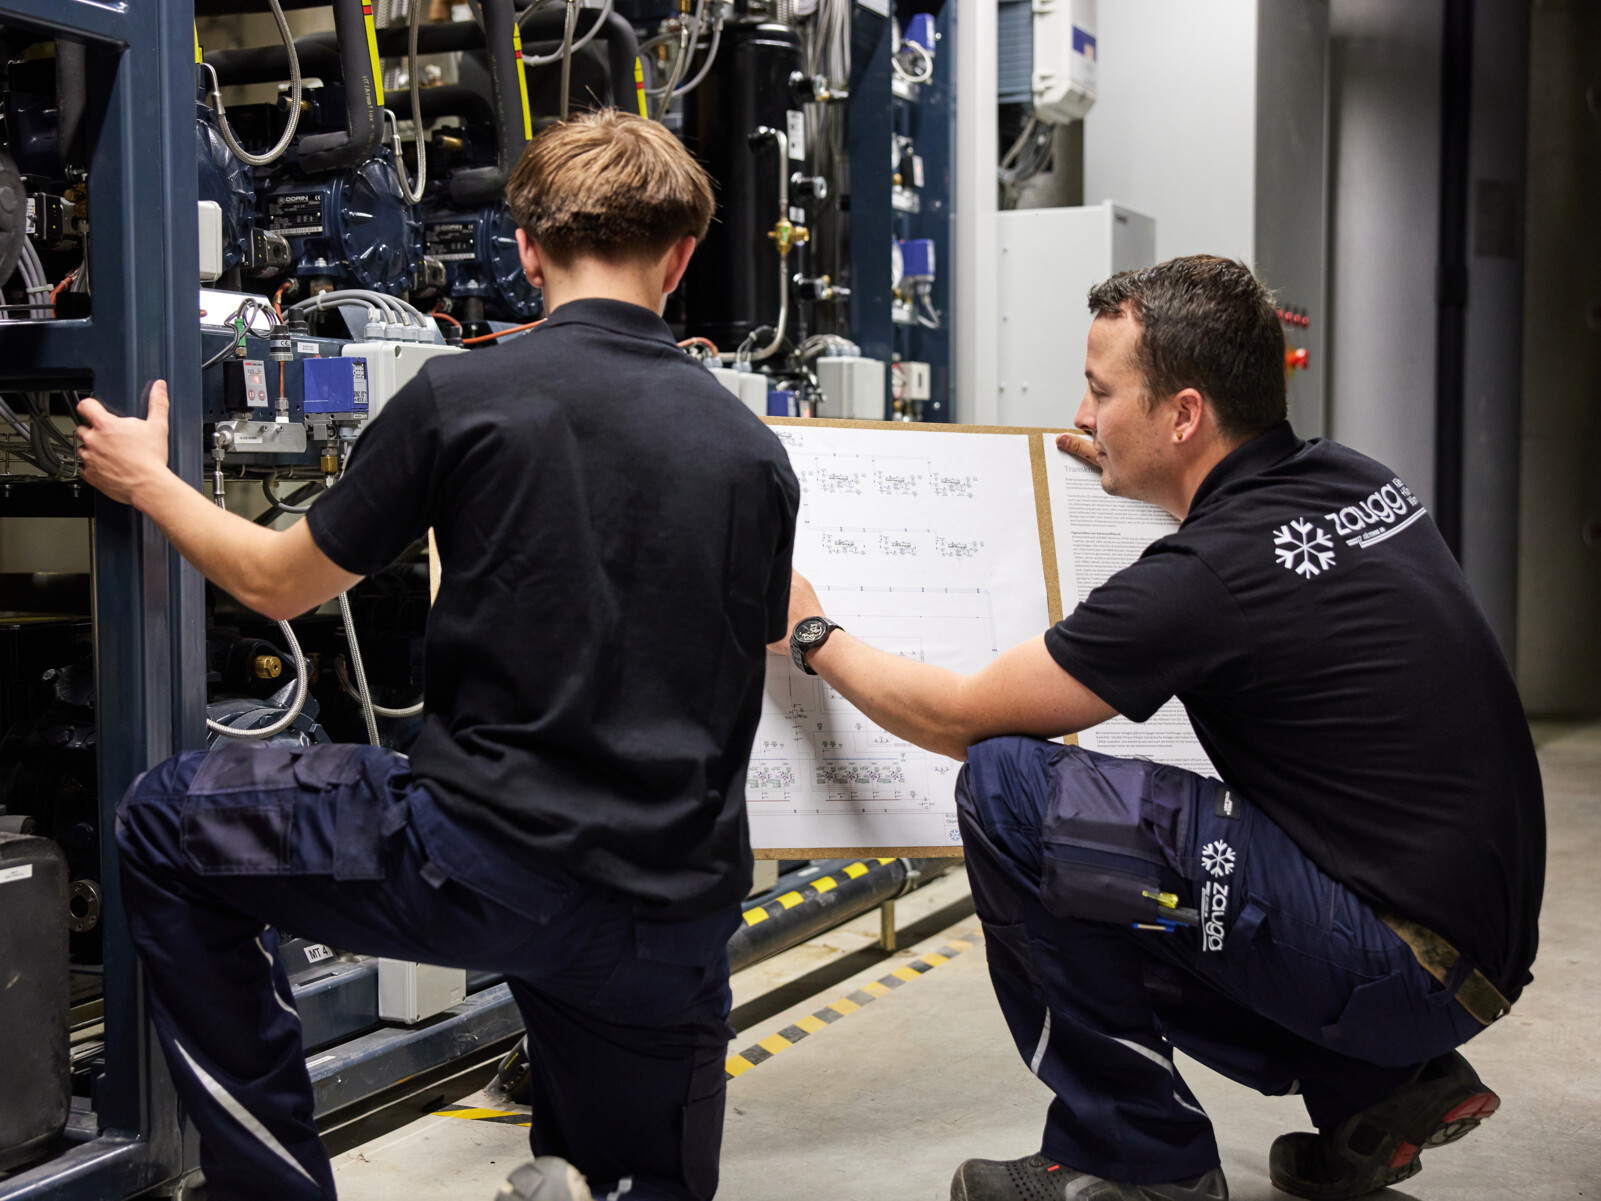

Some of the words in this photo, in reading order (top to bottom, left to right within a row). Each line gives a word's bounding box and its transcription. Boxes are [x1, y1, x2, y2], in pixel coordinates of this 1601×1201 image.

[1324, 483, 1408, 536] zaugg
[308, 947, 322, 960] MT
[322, 945, 329, 956] 4
